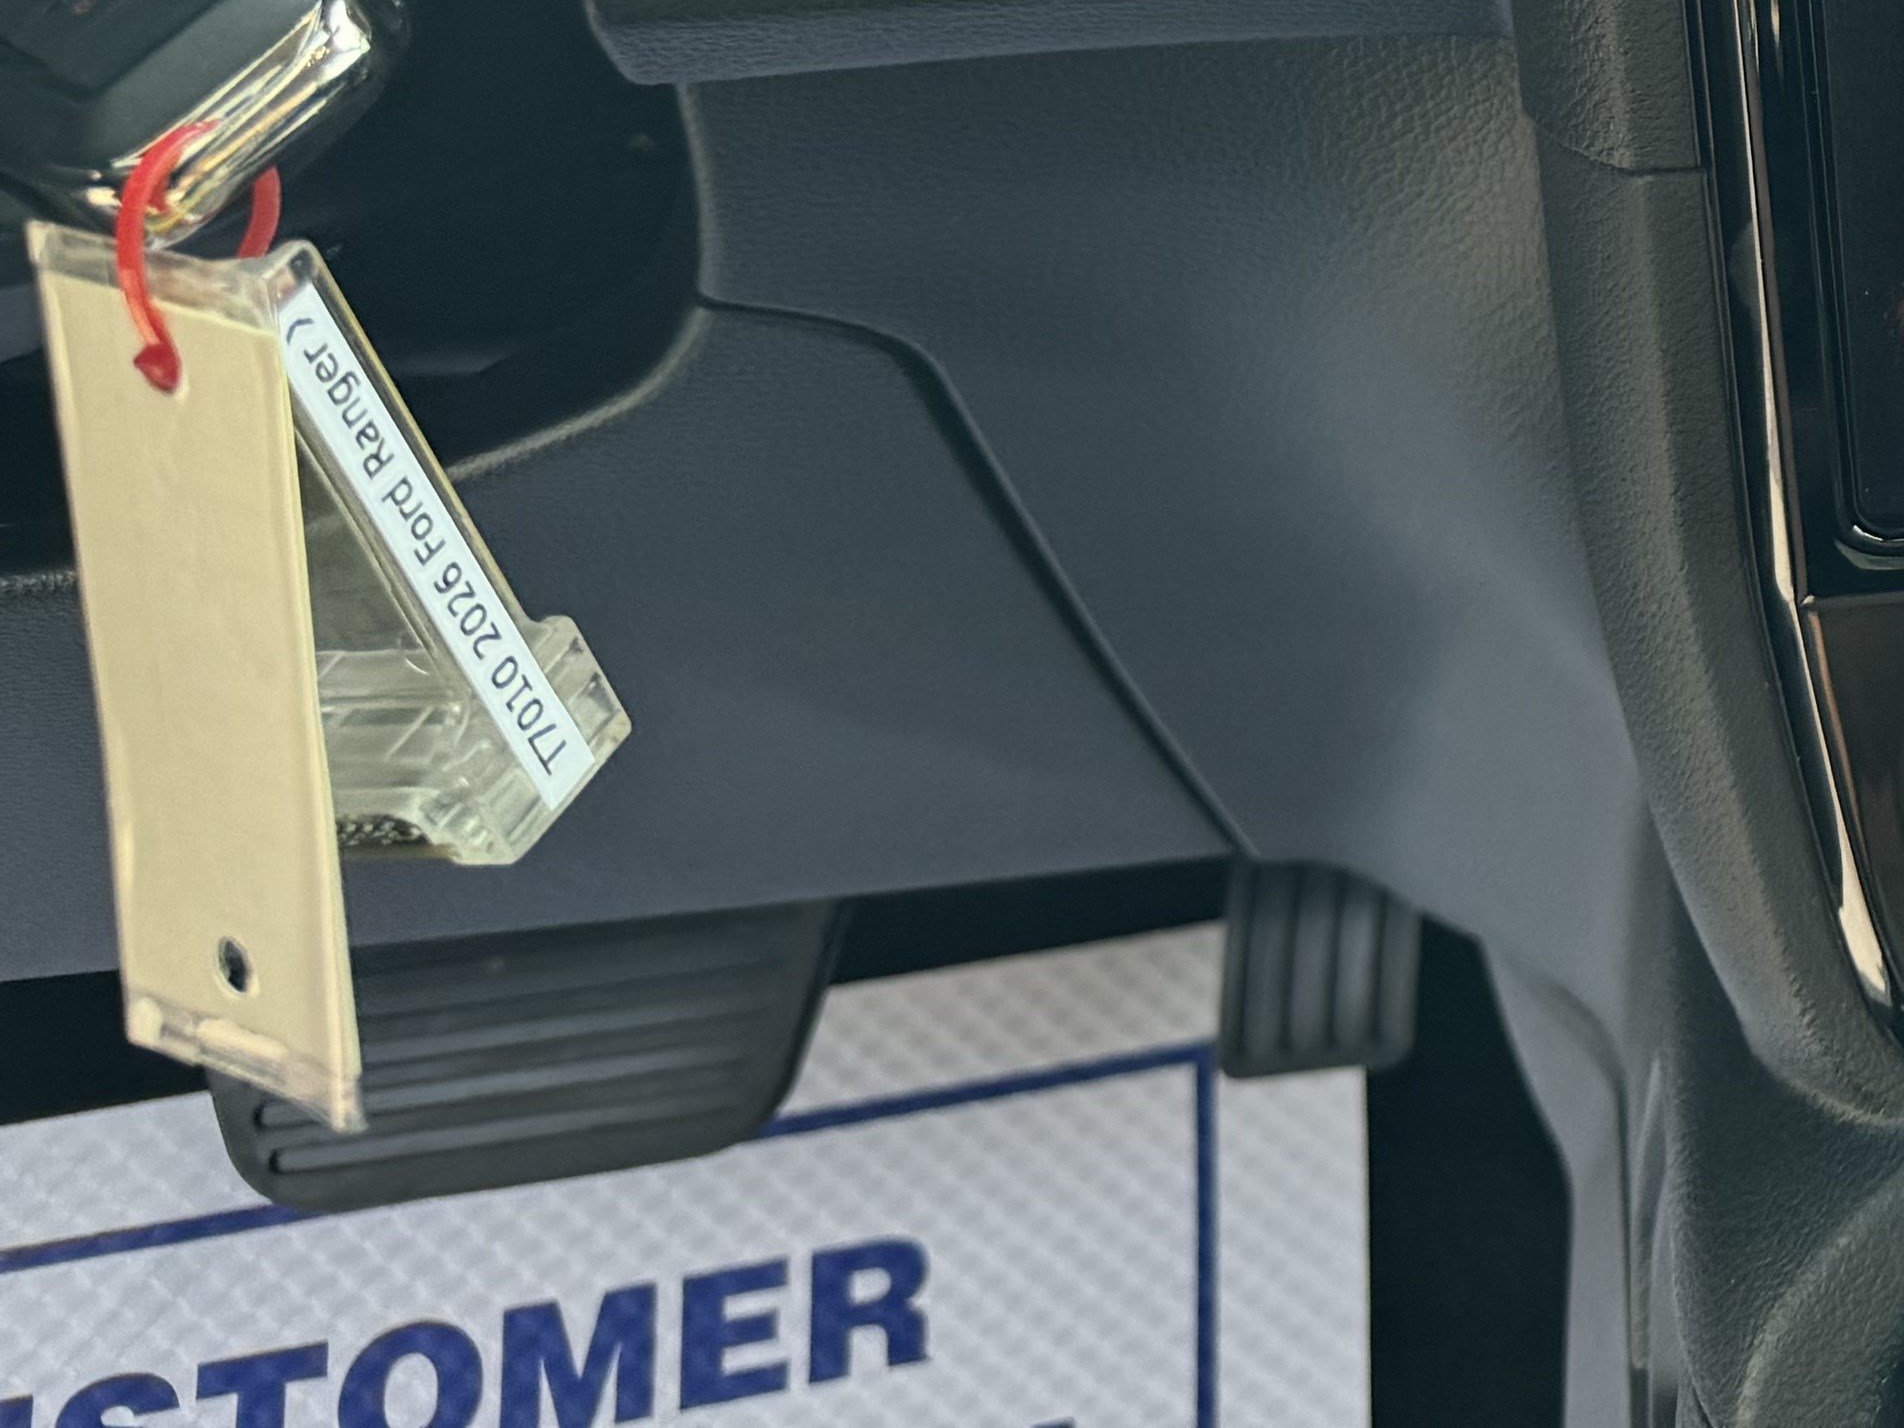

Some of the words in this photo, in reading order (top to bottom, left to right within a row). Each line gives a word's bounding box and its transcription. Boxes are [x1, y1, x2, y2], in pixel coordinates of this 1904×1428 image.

[302, 341, 397, 479] Ranger
[381, 478, 447, 567] Ford
[433, 561, 499, 661] 2026
[490, 654, 568, 778] T7010
